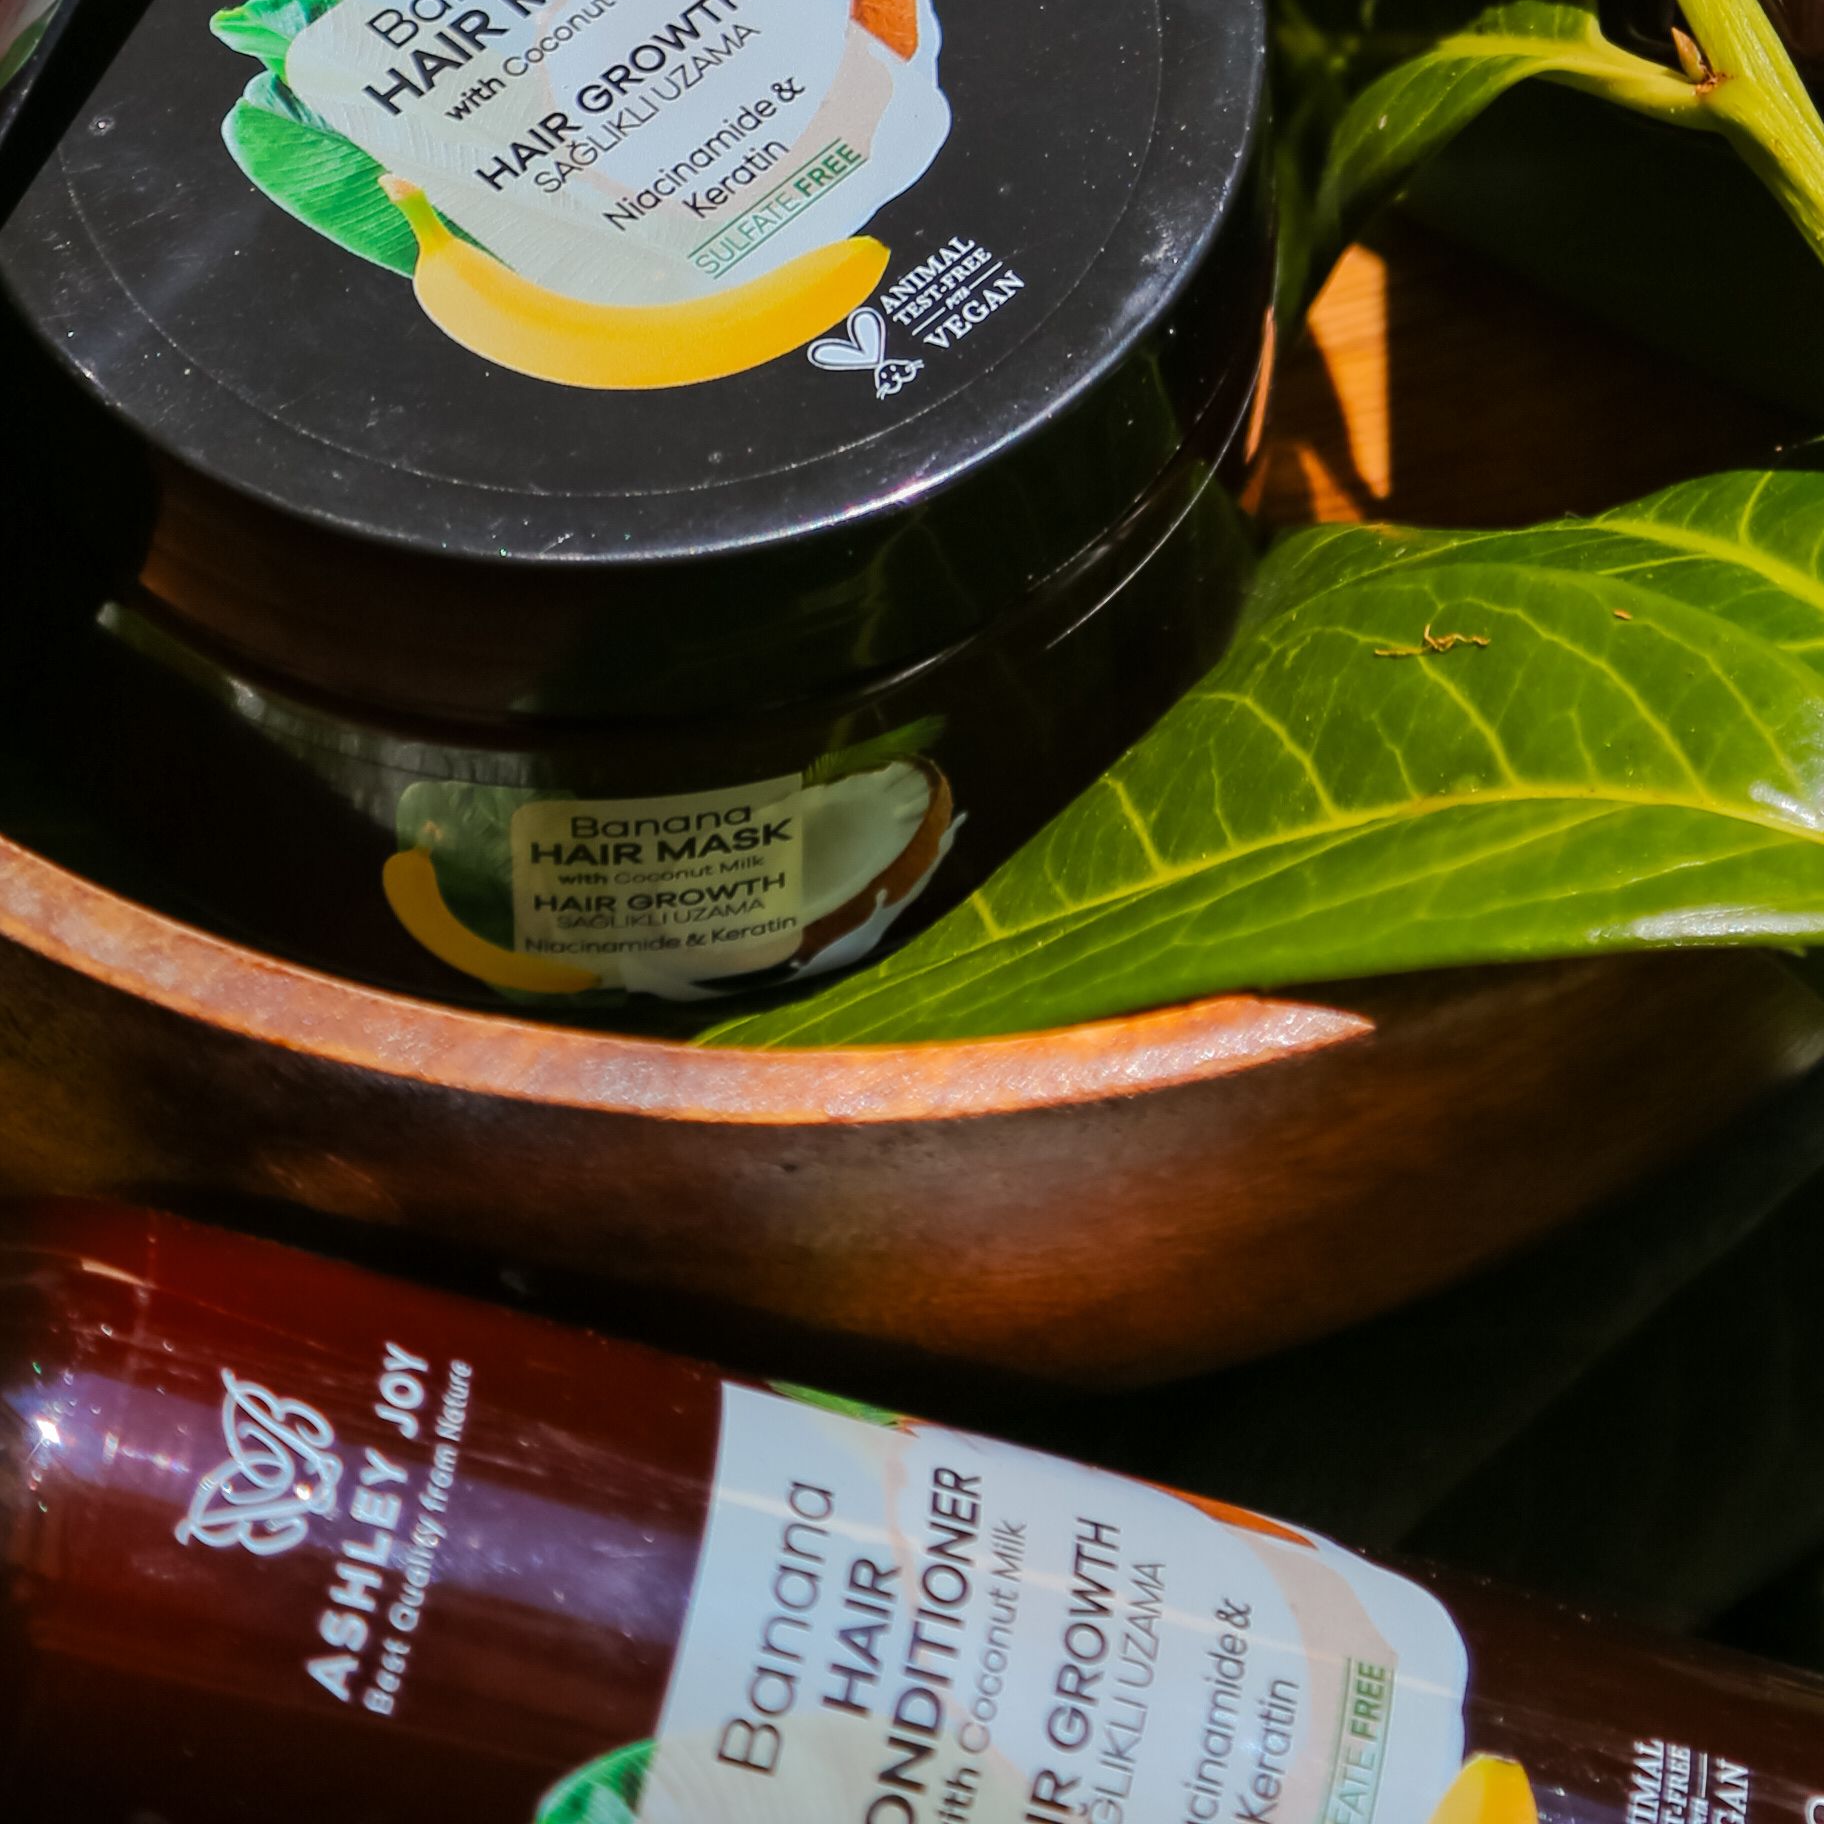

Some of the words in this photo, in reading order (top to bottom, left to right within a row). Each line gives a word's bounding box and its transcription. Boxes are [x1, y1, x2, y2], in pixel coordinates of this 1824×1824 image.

[362, 8, 511, 116] HAIR
[443, 70, 507, 122] with
[533, 95, 660, 196] SAĞLIKLI
[651, 22, 762, 103] UZAMA
[474, 110, 584, 192] HAIR
[602, 97, 778, 232] Niacinamide
[770, 76, 806, 104] &
[681, 139, 790, 220] Keratin
[694, 191, 798, 275] SULFATE
[793, 142, 863, 199] FREE
[879, 236, 976, 315] ANIMAL
[892, 247, 993, 326] TEST-FREE
[922, 269, 1025, 349] VEGAN
[530, 841, 643, 866] HAIR
[657, 817, 793, 863] MASK
[571, 804, 751, 840] Banana
[533, 894, 618, 913] HAIR
[627, 872, 786, 912] GROWTH
[558, 871, 608, 886] with
[614, 861, 714, 885] Coconut
[719, 854, 765, 875] Milk
[525, 936, 682, 953] Niacinamide
[685, 932, 708, 947] &
[710, 915, 798, 945] Keratin
[673, 898, 765, 925] UZAMA
[436, 1359, 473, 1443] Nature
[306, 1448, 409, 1703] ASHLEY
[374, 1341, 430, 1439] JOY
[420, 1446, 459, 1518] from
[389, 1517, 447, 1633] Quality
[1215, 1597, 1252, 1630] &
[717, 1480, 835, 1776] Banana
[822, 1557, 902, 1718] HAIR
[959, 1590, 1020, 1754] Coconut
[991, 1519, 1027, 1583] Milk
[1046, 1517, 1122, 1752] GROWTH
[1118, 1560, 1167, 1693] UZAMA
[362, 1640, 412, 1717] Best
[1351, 1660, 1386, 1741] FREE
[1183, 1632, 1249, 1824] cinamide
[1233, 1678, 1300, 1824] Keratin
